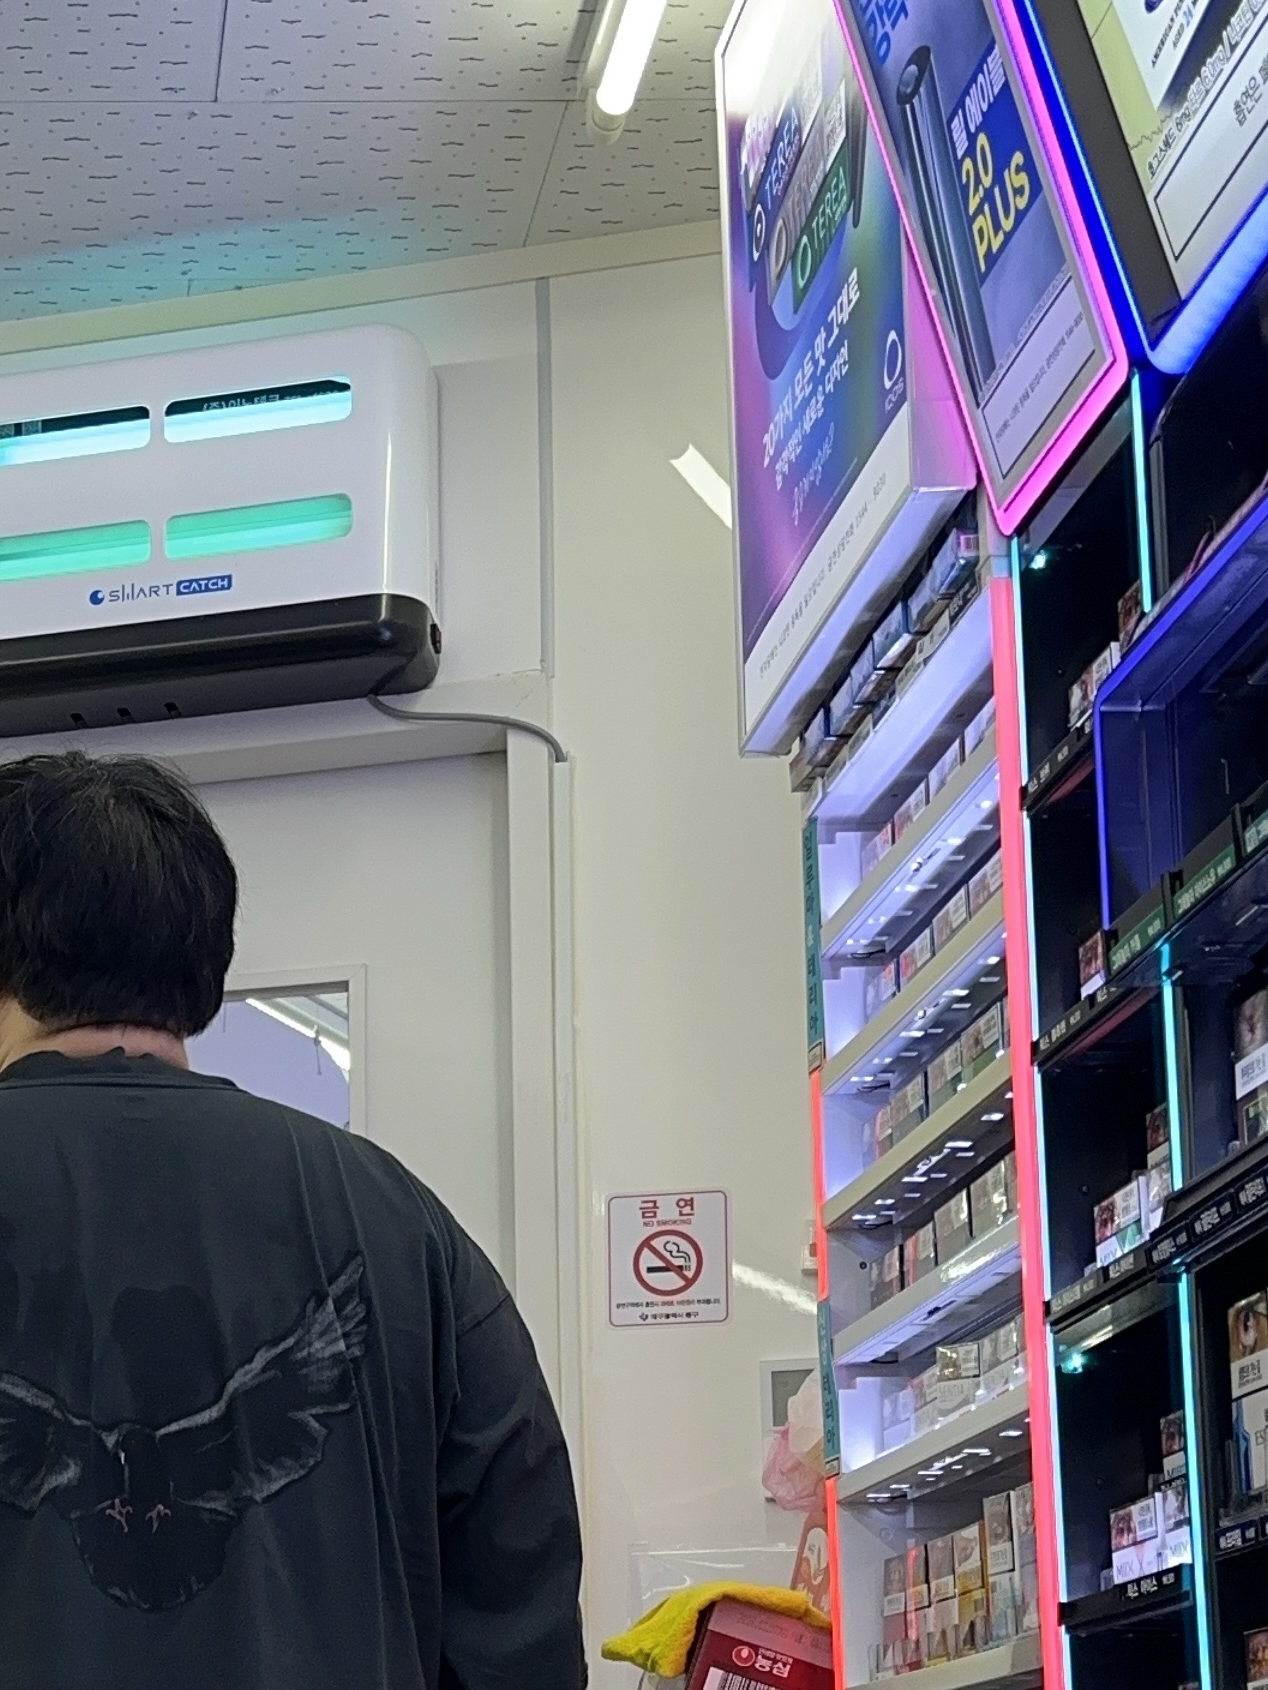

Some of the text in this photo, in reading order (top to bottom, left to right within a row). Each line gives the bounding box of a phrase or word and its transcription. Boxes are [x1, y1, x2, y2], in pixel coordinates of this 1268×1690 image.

[962, 131, 993, 205] 2.0
[812, 166, 847, 250] TEREA
[971, 150, 1030, 272] PLUS
[762, 389, 794, 469] 20가지
[794, 350, 814, 407] 모든
[814, 326, 827, 377] 맛
[827, 266, 860, 348] 그대로
[180, 578, 229, 593] CATCH
[639, 1196, 695, 1219] 금 연
[754, 1655, 791, 1678] 농심
